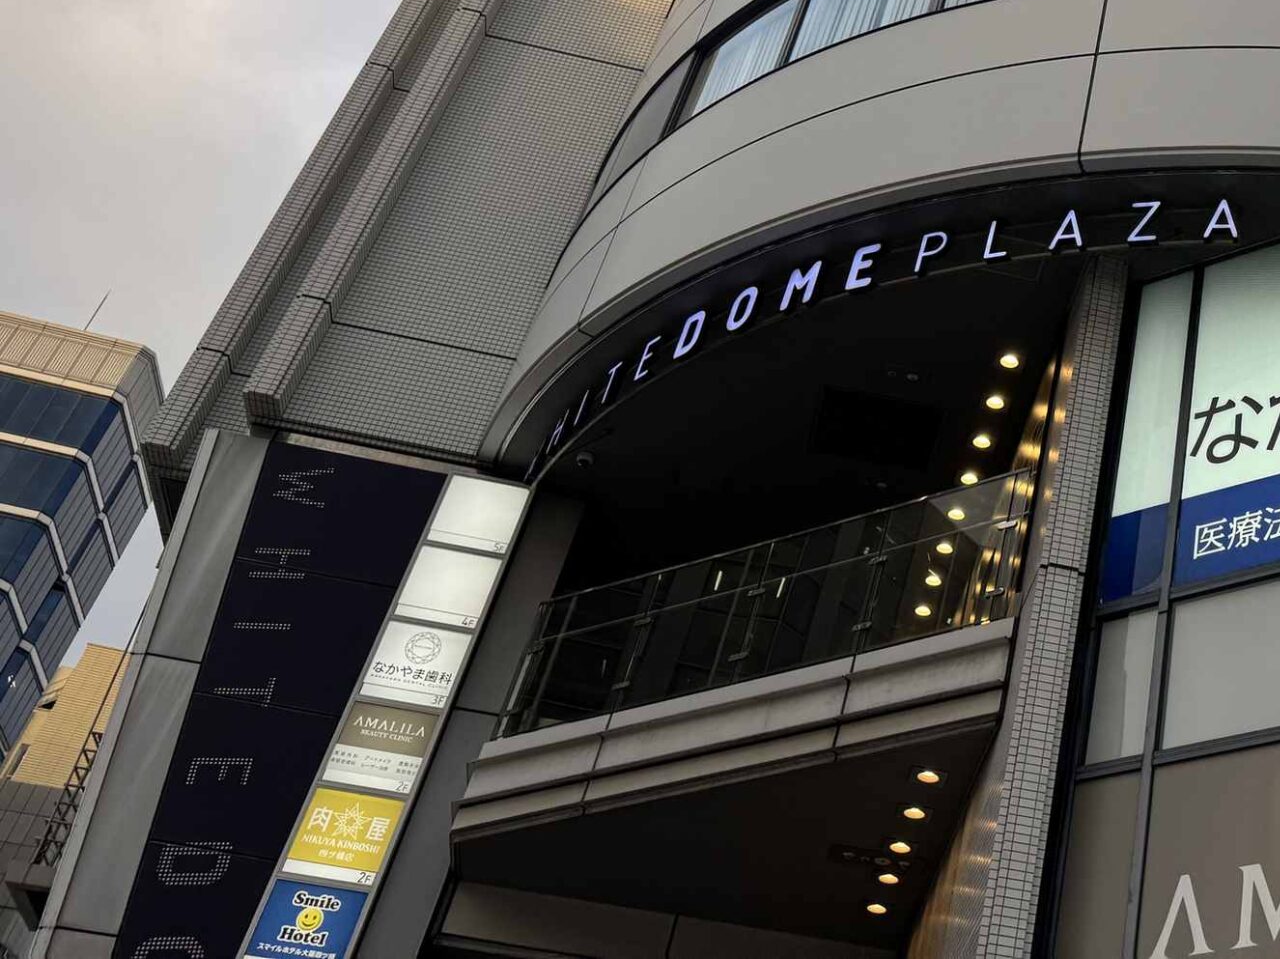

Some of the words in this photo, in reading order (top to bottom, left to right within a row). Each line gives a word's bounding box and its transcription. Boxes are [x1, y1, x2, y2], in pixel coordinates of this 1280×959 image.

[494, 542, 505, 552] 5F
[462, 617, 475, 627] 4F
[372, 660, 453, 685] なかやま歯科
[432, 695, 445, 705] 3F
[353, 715, 426, 738] AMALILA
[388, 733, 414, 743] CLINIC
[395, 781, 408, 792] 2F
[307, 806, 334, 833] 肉
[364, 815, 391, 842] 屋
[301, 833, 336, 848] NIKUYA
[336, 839, 381, 855] KINBOSHI
[357, 871, 372, 884] 2F
[293, 891, 341, 911] Smile
[277, 925, 328, 946] Hotel
